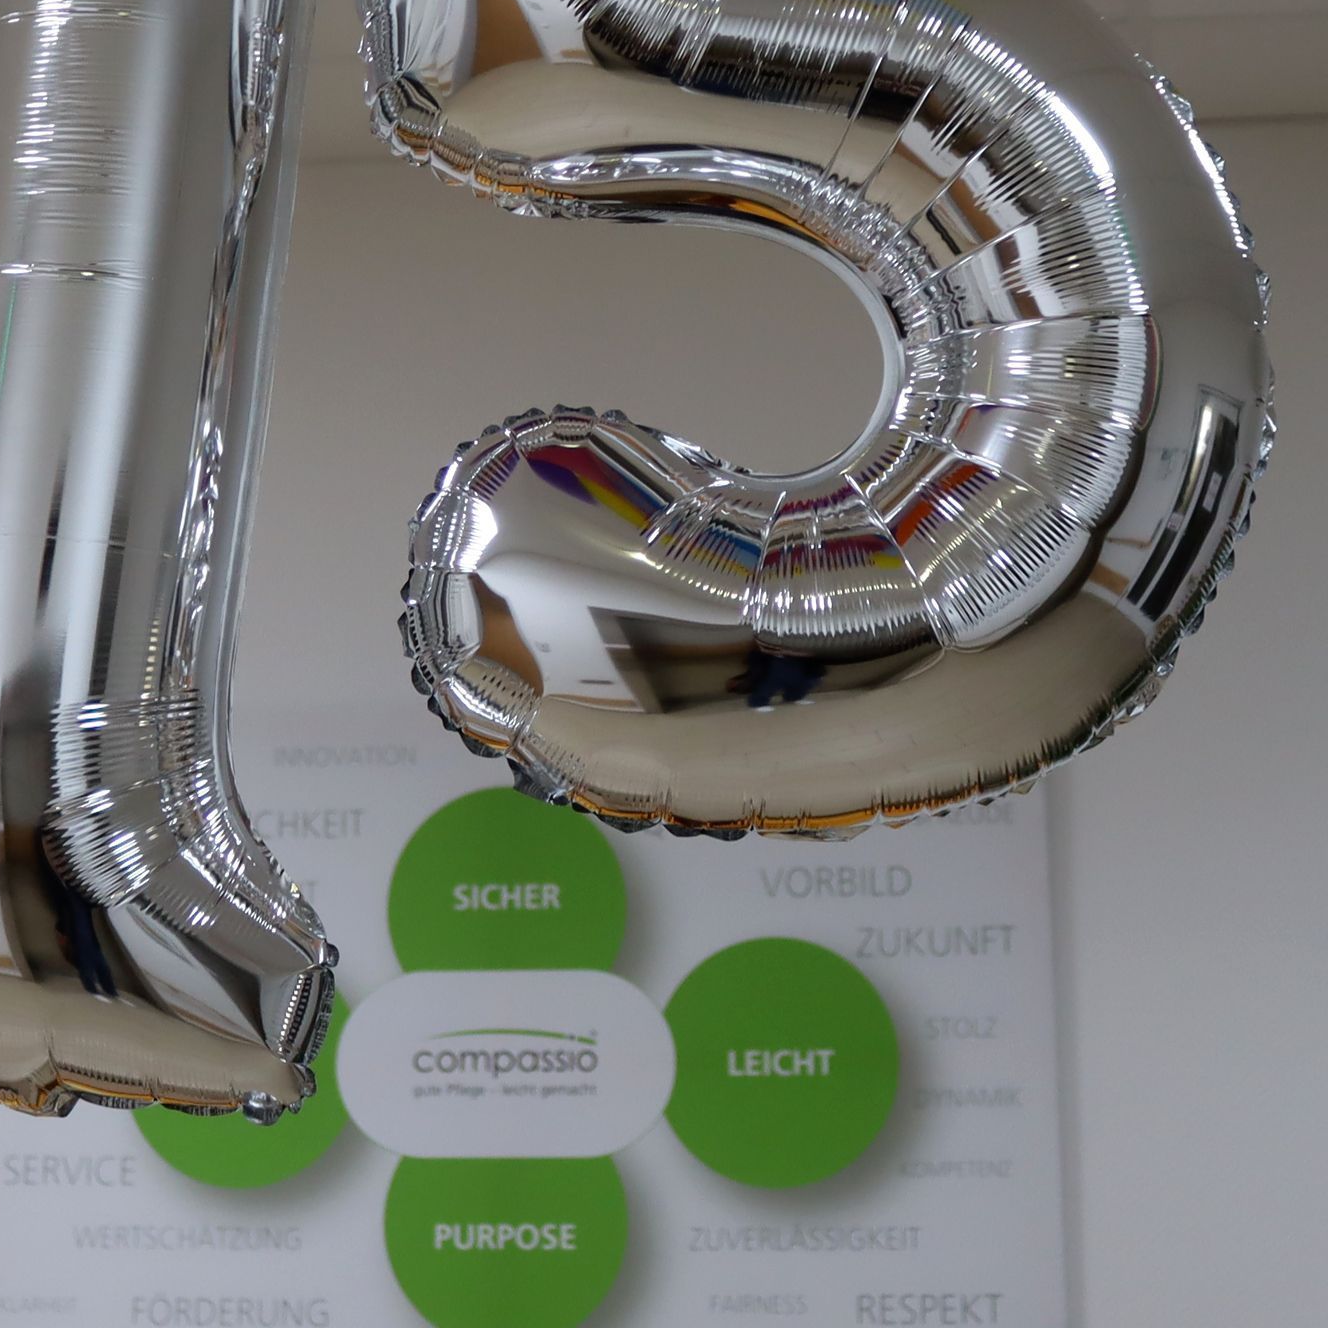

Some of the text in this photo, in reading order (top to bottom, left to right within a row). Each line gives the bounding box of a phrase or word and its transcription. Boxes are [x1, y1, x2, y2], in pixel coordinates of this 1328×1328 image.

[274, 745, 417, 768] INNOVATION
[251, 808, 366, 840] CHKEIT
[759, 864, 913, 899] VORBILD
[453, 883, 560, 913] SICHER
[856, 924, 1018, 959] ZUKUNFT
[925, 1015, 998, 1040] STOLZ
[411, 1047, 599, 1078] compassio
[727, 1048, 834, 1078] LEICHT
[915, 1088, 1022, 1107] DYNAMIK
[2, 1152, 137, 1187] SERVICE
[433, 1221, 576, 1252] PURPOSE
[688, 1223, 924, 1253] ZUVERLÄSSIGKEIT
[130, 1293, 330, 1328] FÖRDERUNG
[708, 1293, 809, 1317] FAIRNESS
[855, 1292, 1005, 1326] RESPEKT
